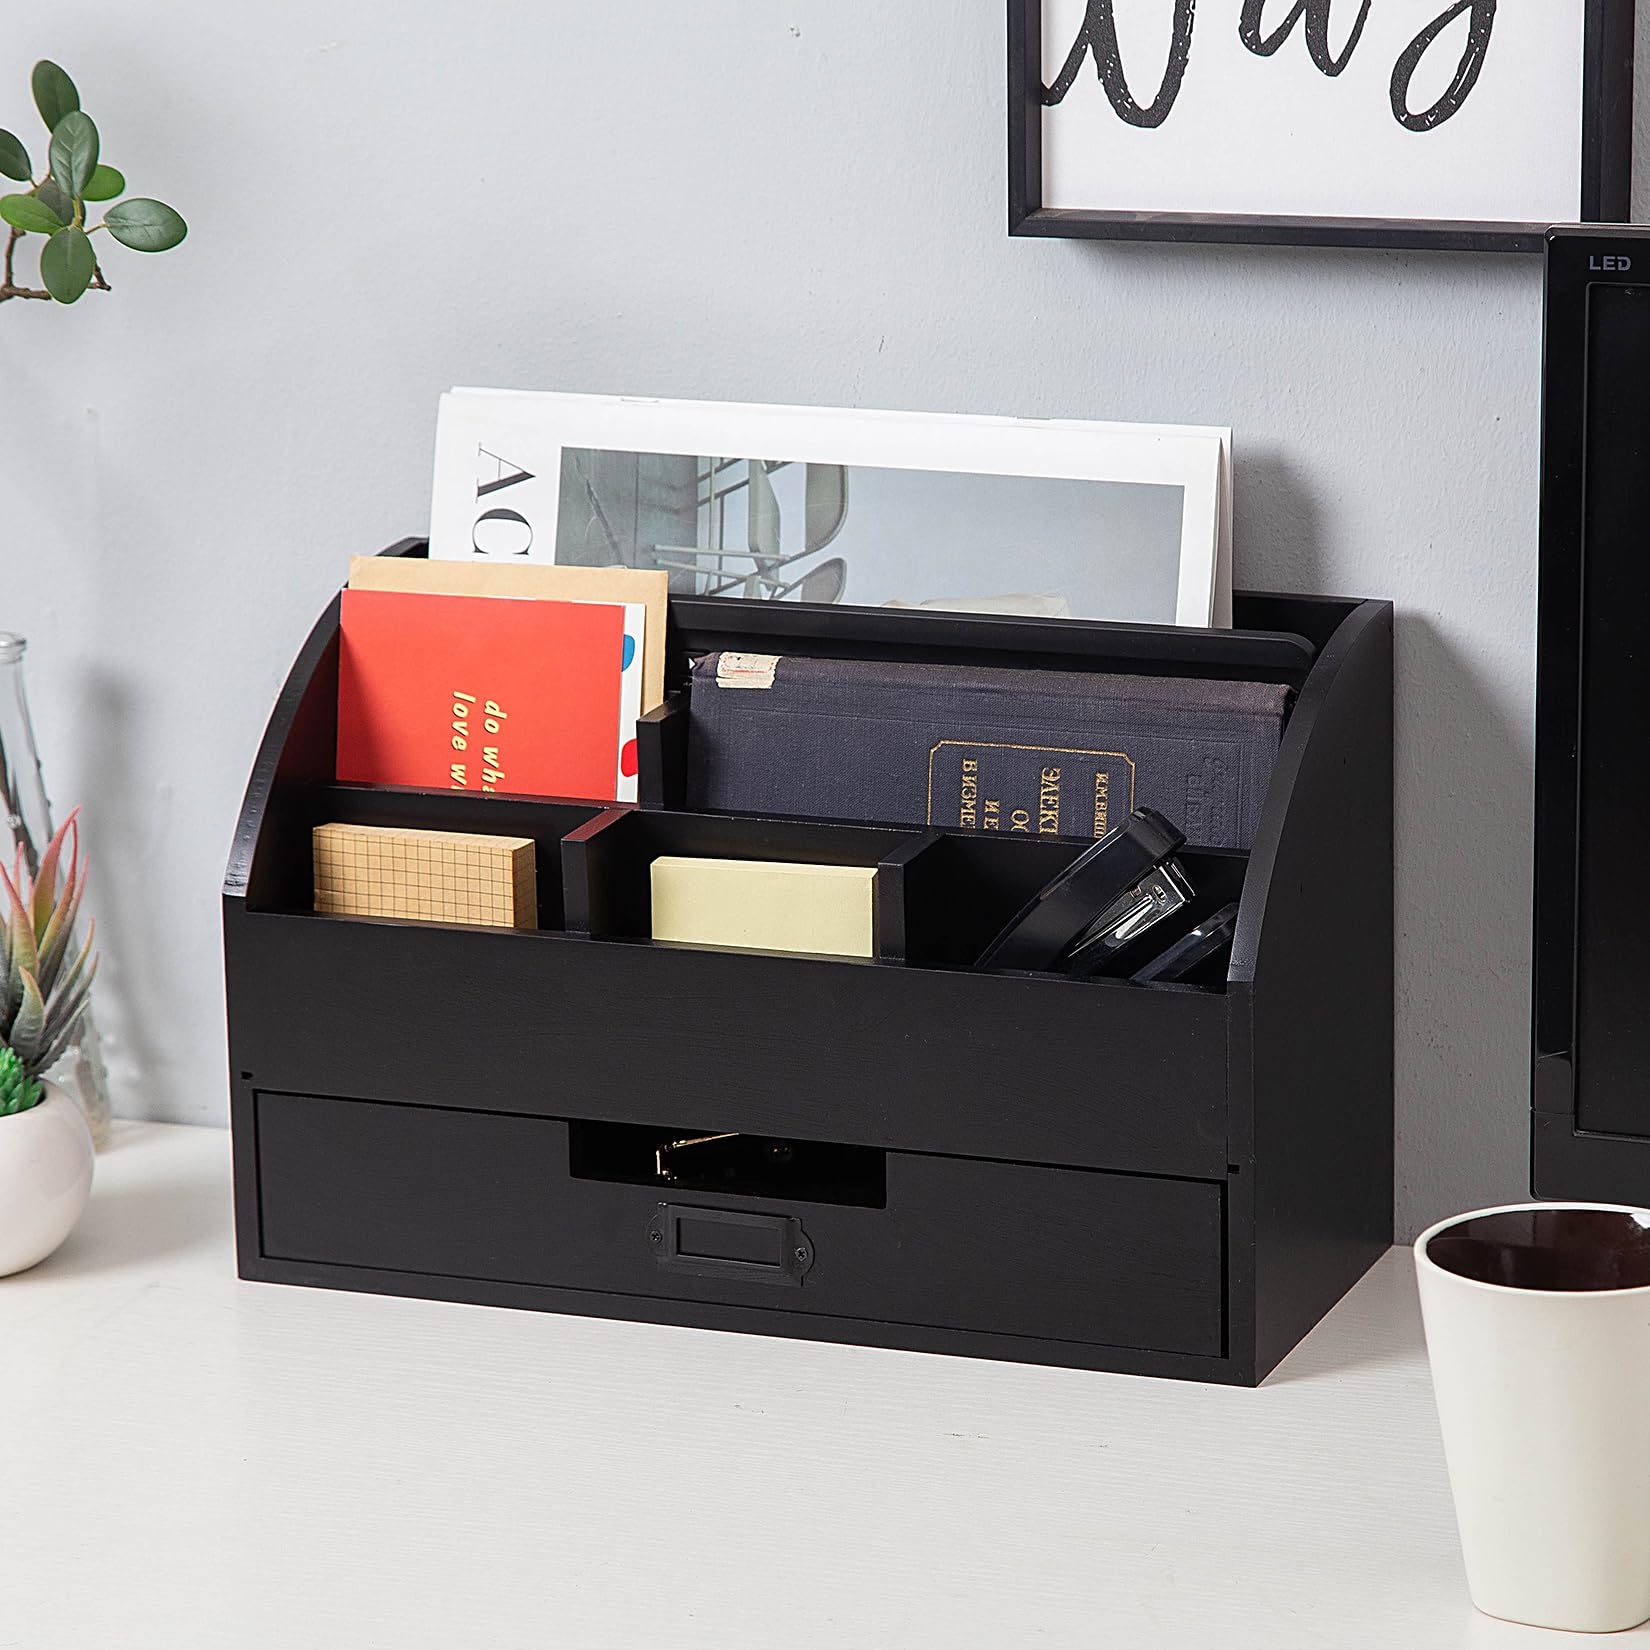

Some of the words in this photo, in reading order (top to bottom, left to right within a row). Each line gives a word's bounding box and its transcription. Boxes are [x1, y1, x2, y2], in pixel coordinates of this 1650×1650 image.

[1589, 255, 1632, 271] LED
[471, 441, 536, 555] AC
[451, 690, 477, 751] love
[483, 699, 508, 734] do
[449, 763, 467, 790] w
[960, 774, 977, 829] ИЗМЕ
